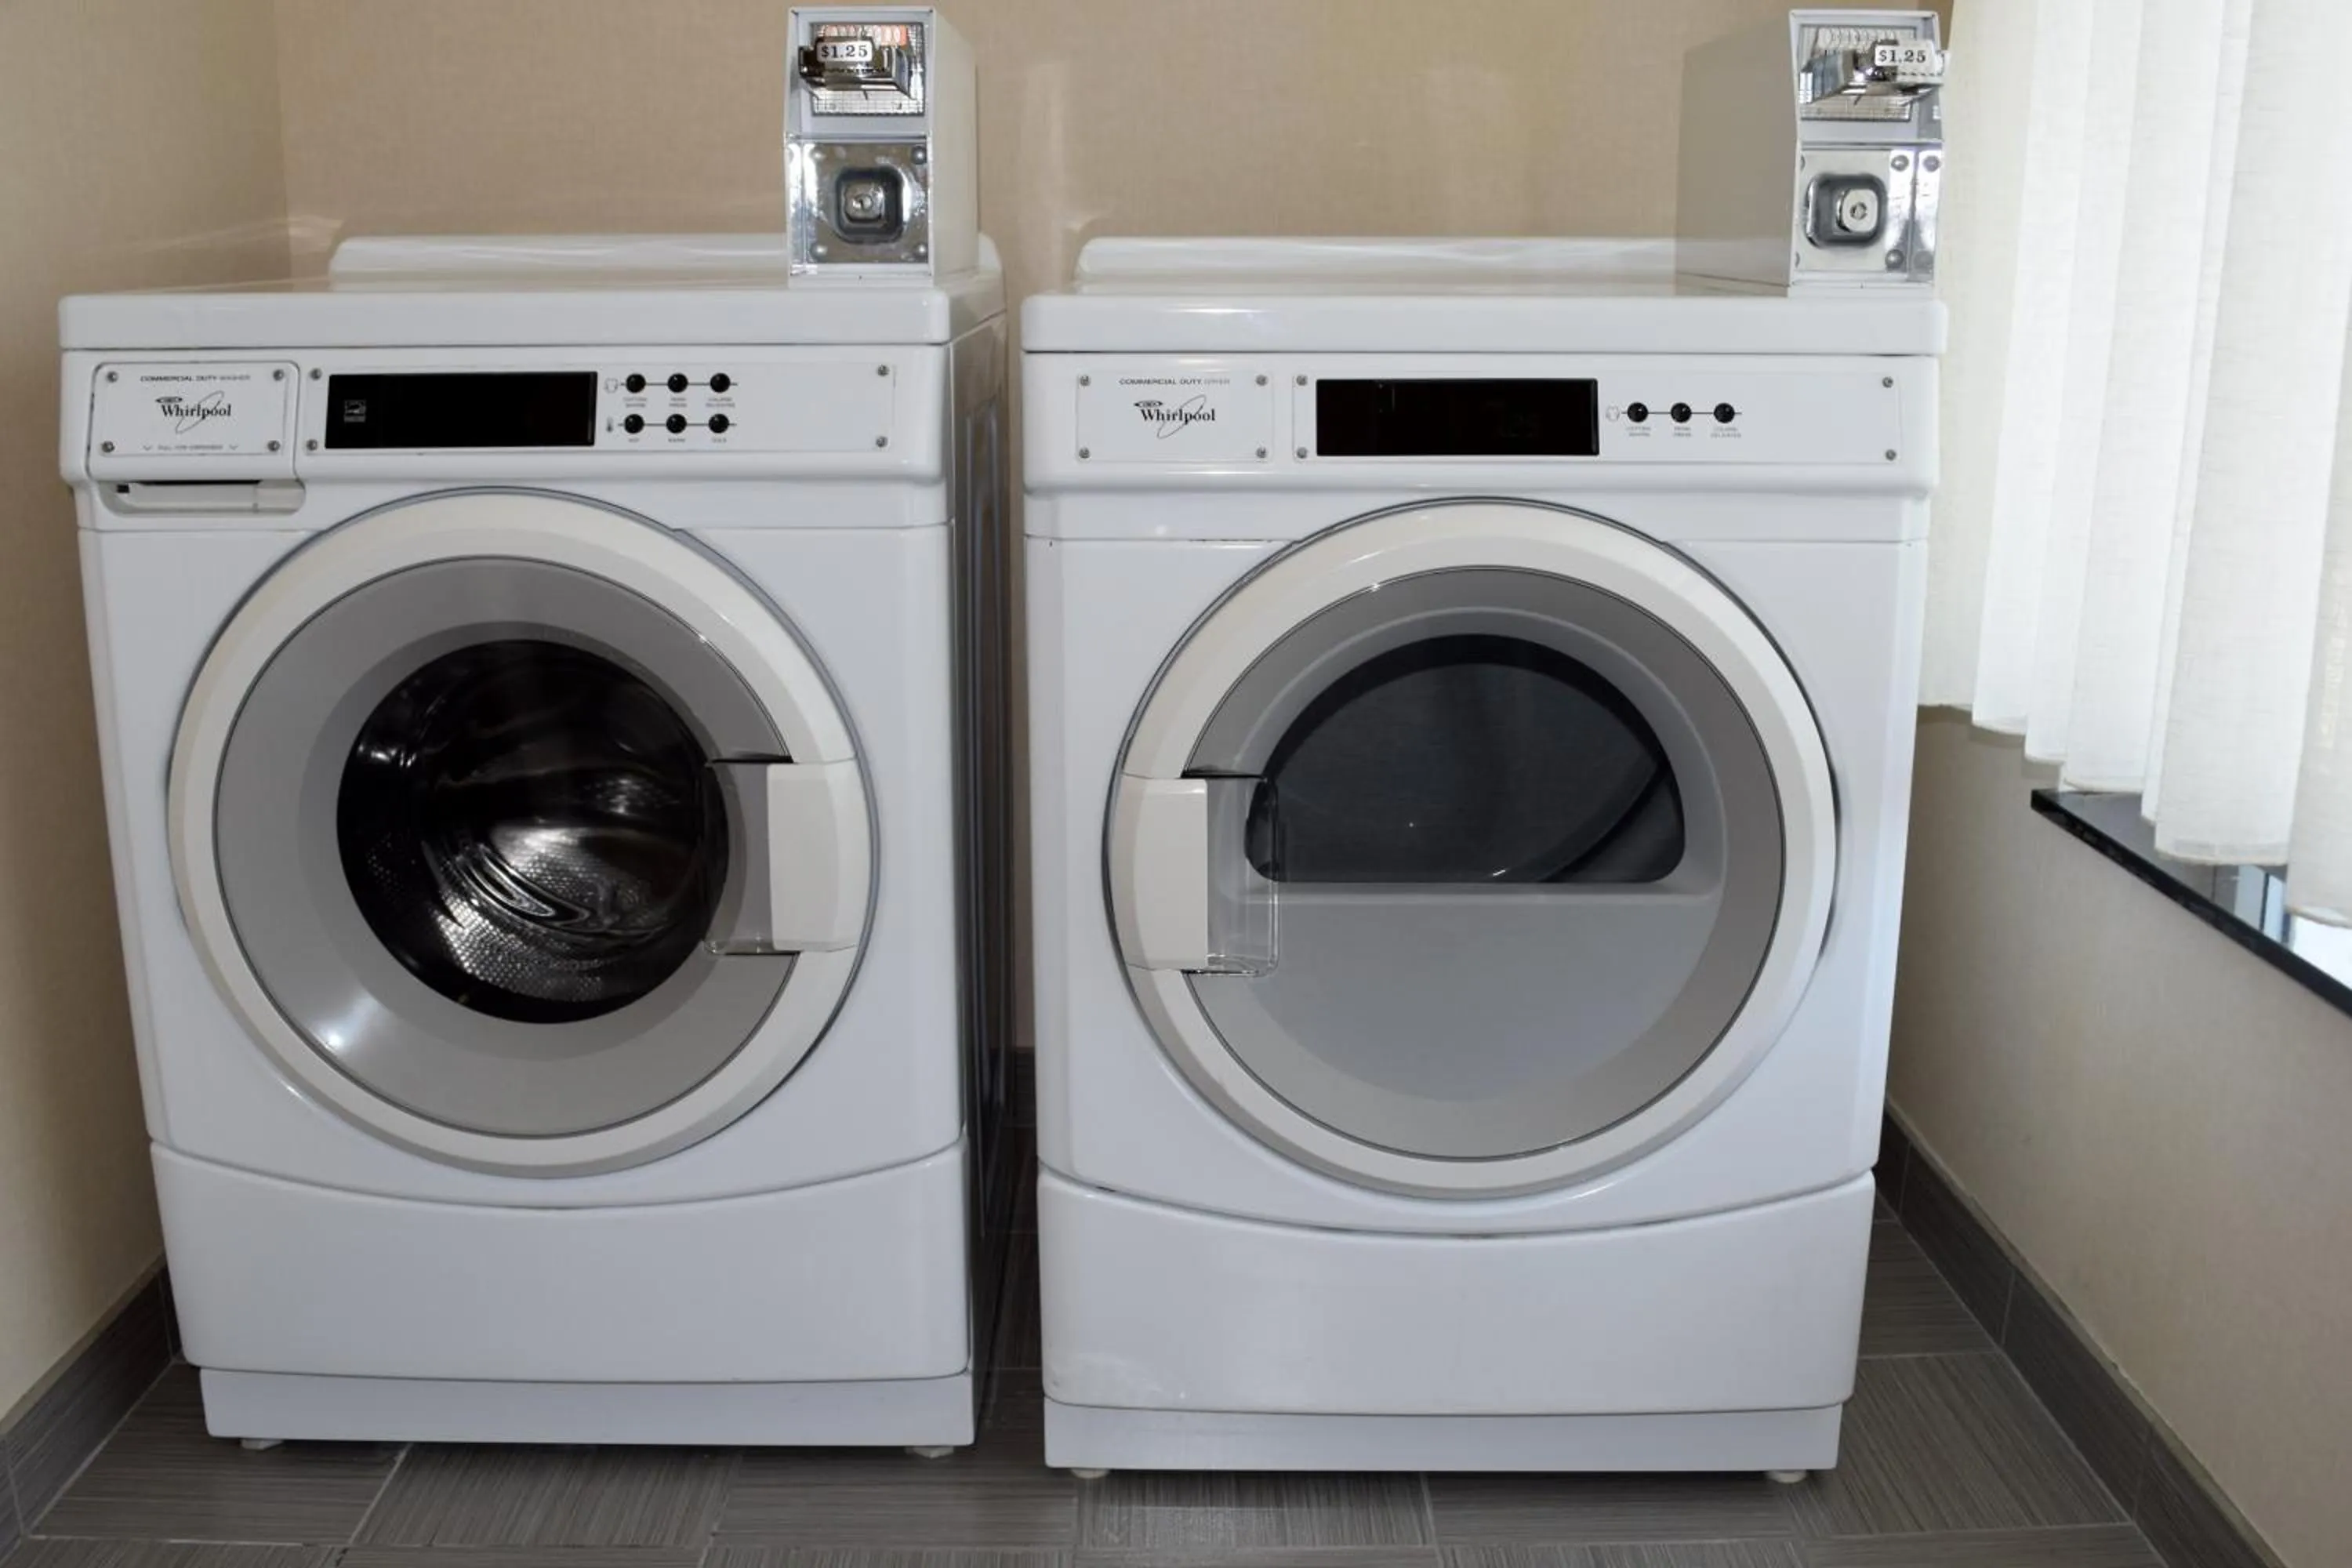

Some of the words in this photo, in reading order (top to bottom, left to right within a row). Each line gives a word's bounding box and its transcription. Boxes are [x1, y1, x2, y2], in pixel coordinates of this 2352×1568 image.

[821, 45, 868, 58] $1.25
[1878, 49, 1926, 63] $1.25
[161, 404, 231, 420] Whirlpool
[1140, 408, 1215, 425] Whirlpool
